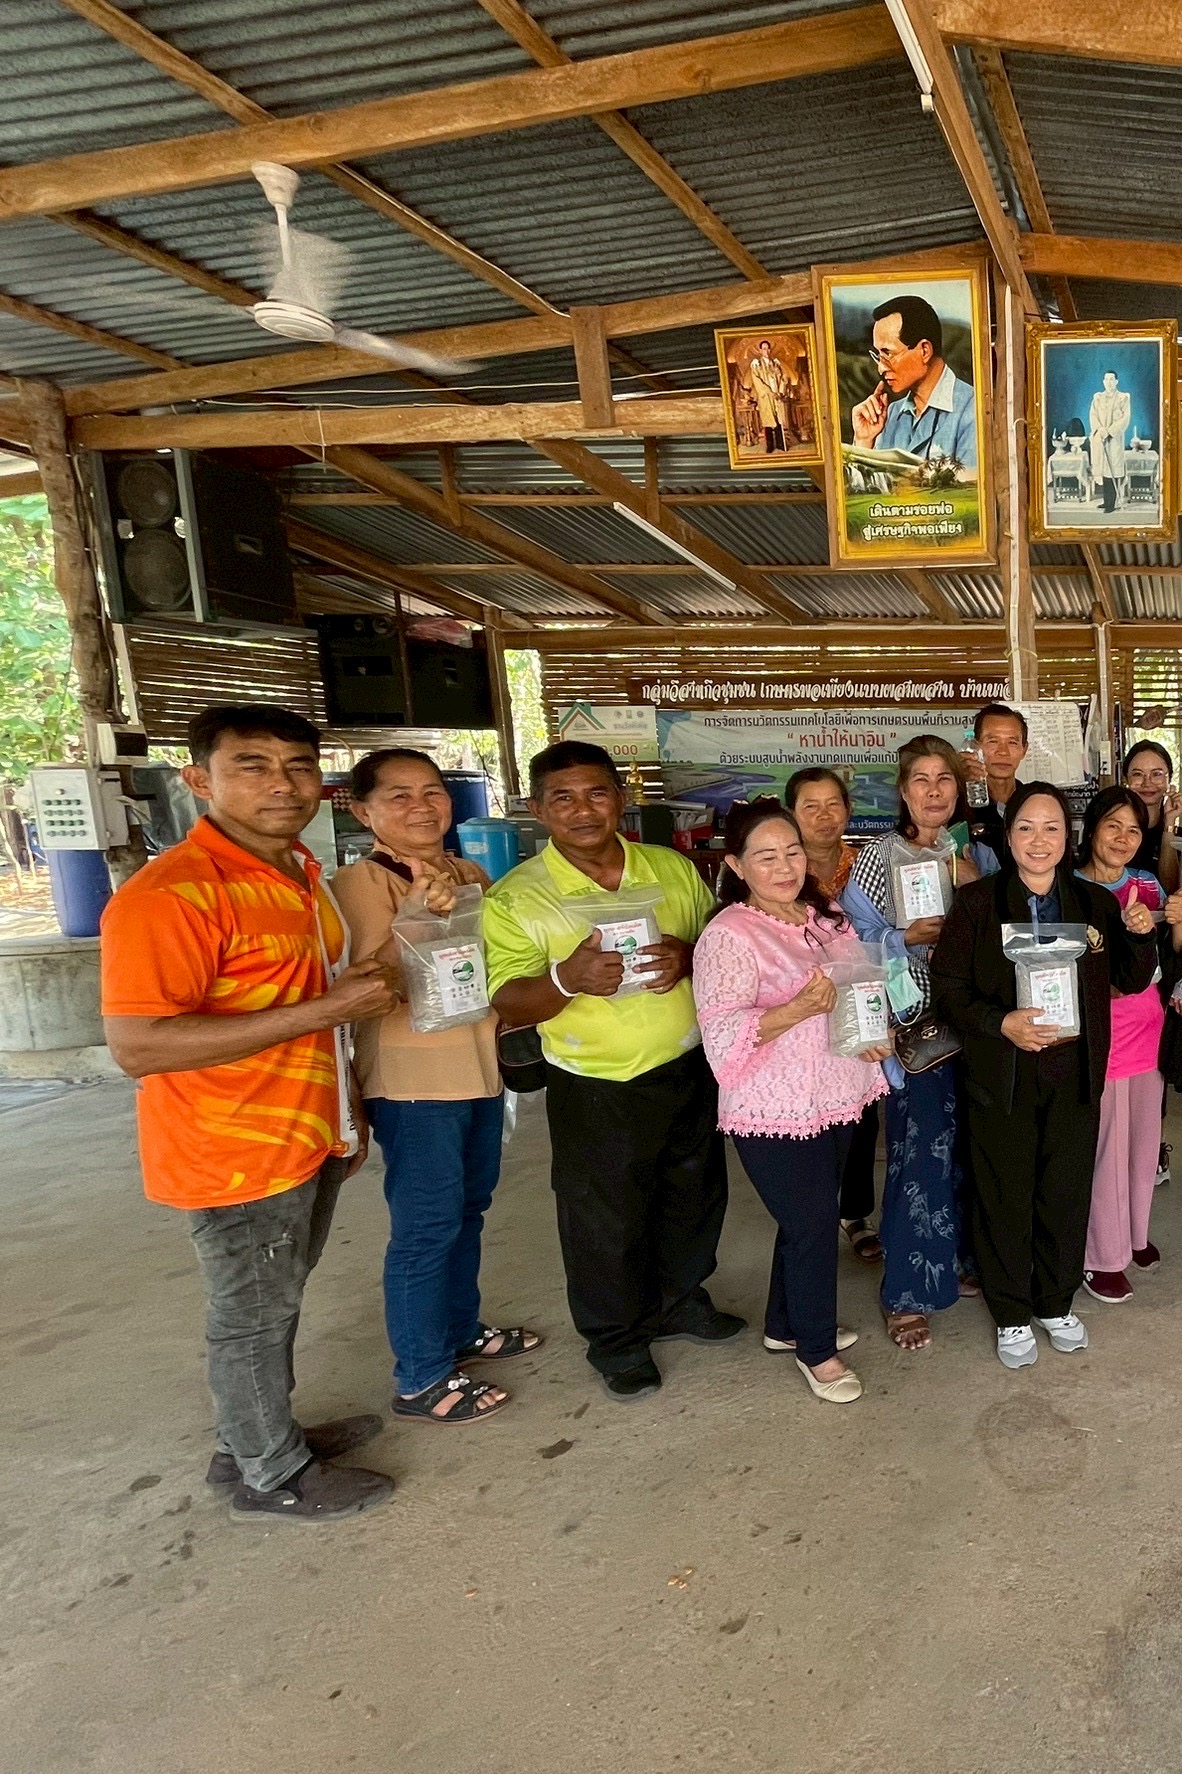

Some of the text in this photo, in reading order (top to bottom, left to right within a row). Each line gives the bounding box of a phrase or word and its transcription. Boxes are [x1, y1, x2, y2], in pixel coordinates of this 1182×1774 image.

[869, 501, 954, 518] เดินตามรอยพ่อ
